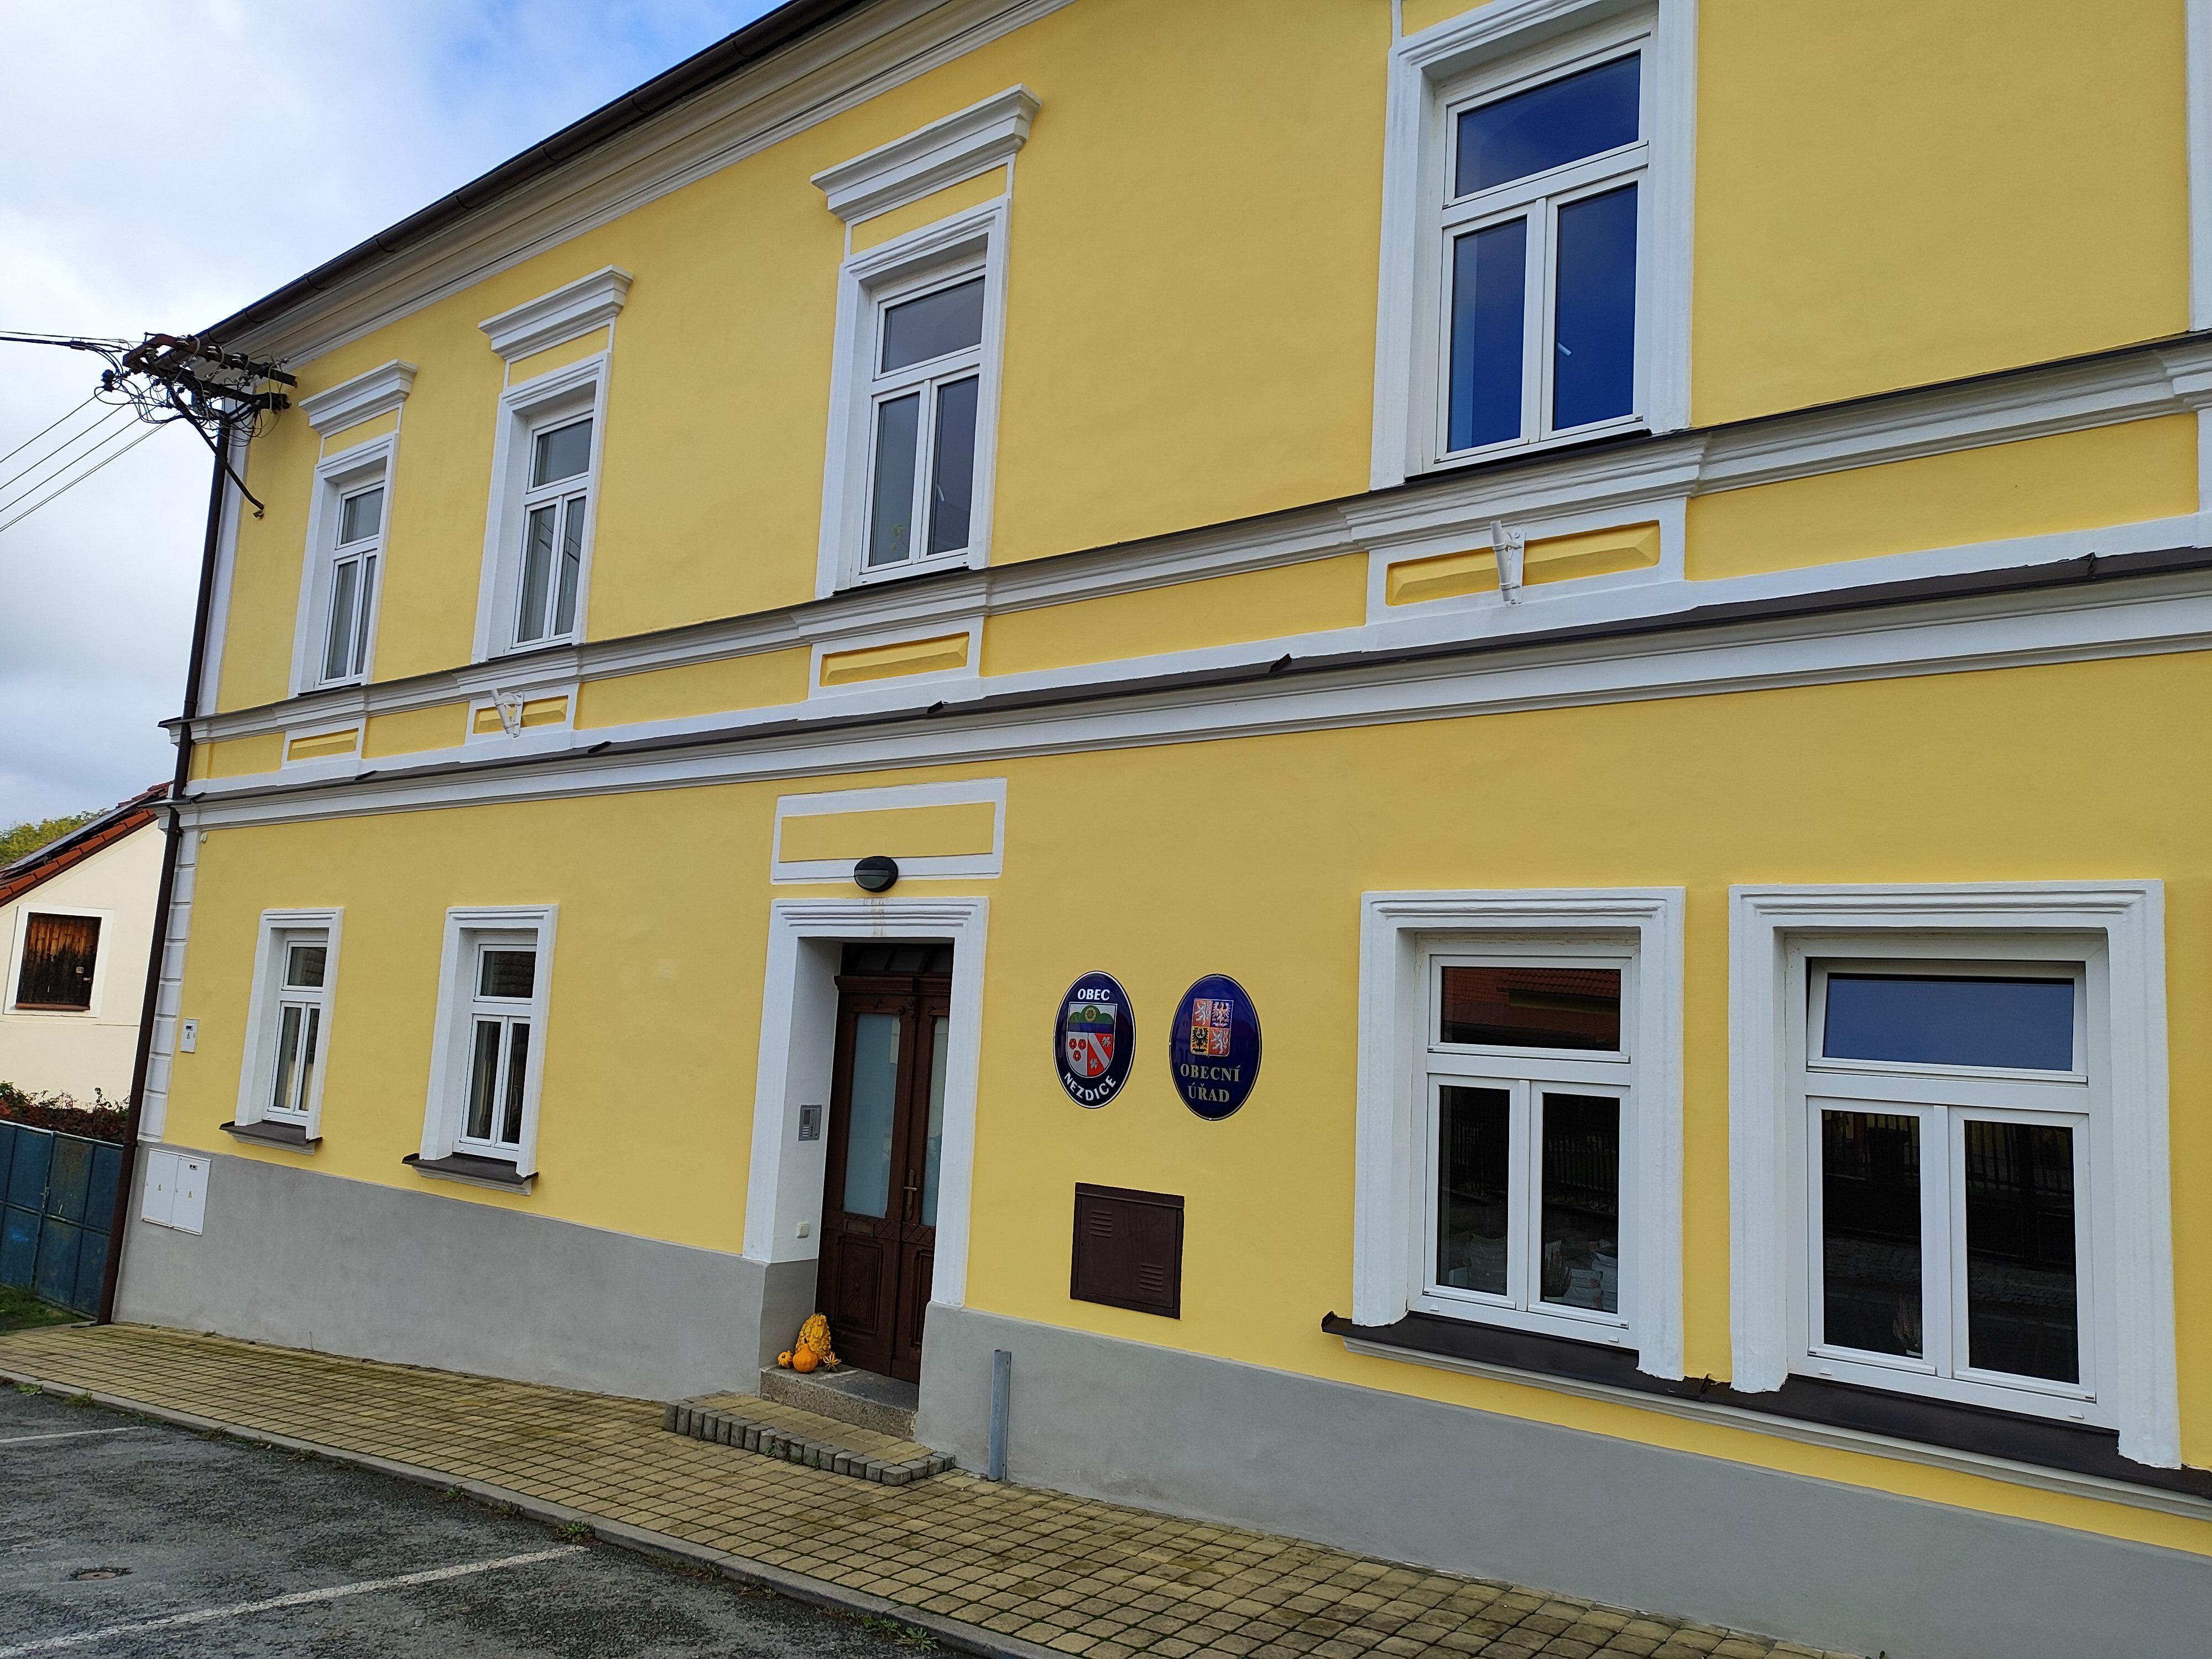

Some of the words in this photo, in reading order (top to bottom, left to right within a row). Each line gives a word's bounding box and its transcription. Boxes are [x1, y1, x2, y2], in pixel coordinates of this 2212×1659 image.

[1077, 988, 1110, 1000] OBEC
[1180, 1063, 1241, 1082] OBECNÍ
[1064, 1072, 1117, 1101] NEZDICE
[1187, 1083, 1230, 1103] ÚŘAD
